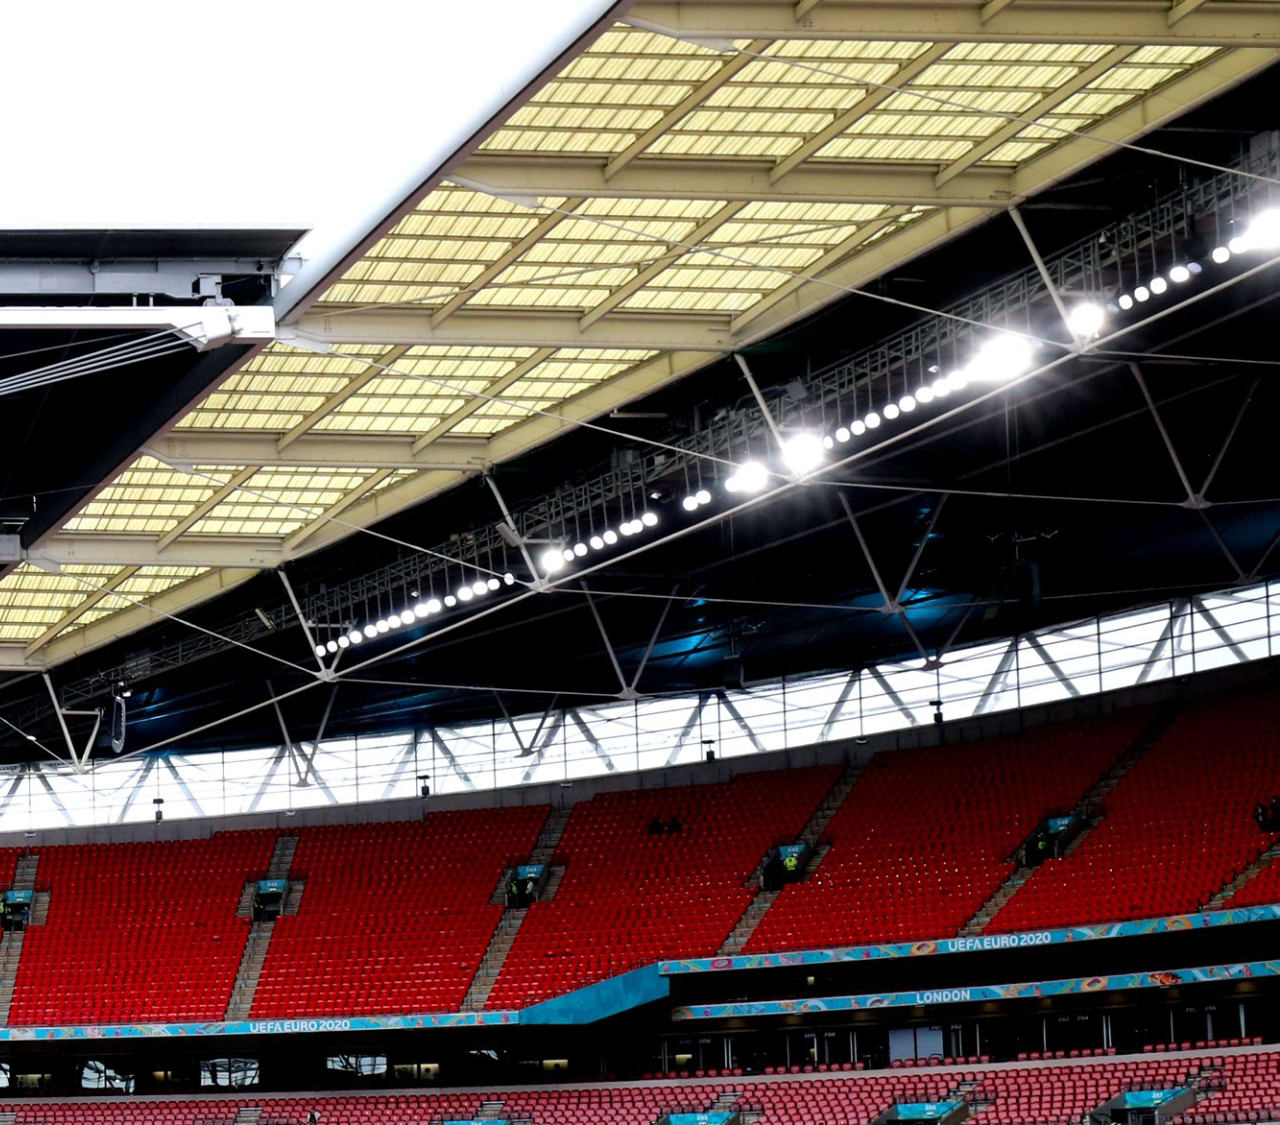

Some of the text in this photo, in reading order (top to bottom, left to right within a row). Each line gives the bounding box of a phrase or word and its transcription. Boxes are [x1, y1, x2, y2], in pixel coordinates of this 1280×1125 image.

[948, 931, 1051, 952] UEFA EURO 2020
[916, 989, 970, 1004] LONDON
[249, 1020, 350, 1033] UEFA EURO 2020
